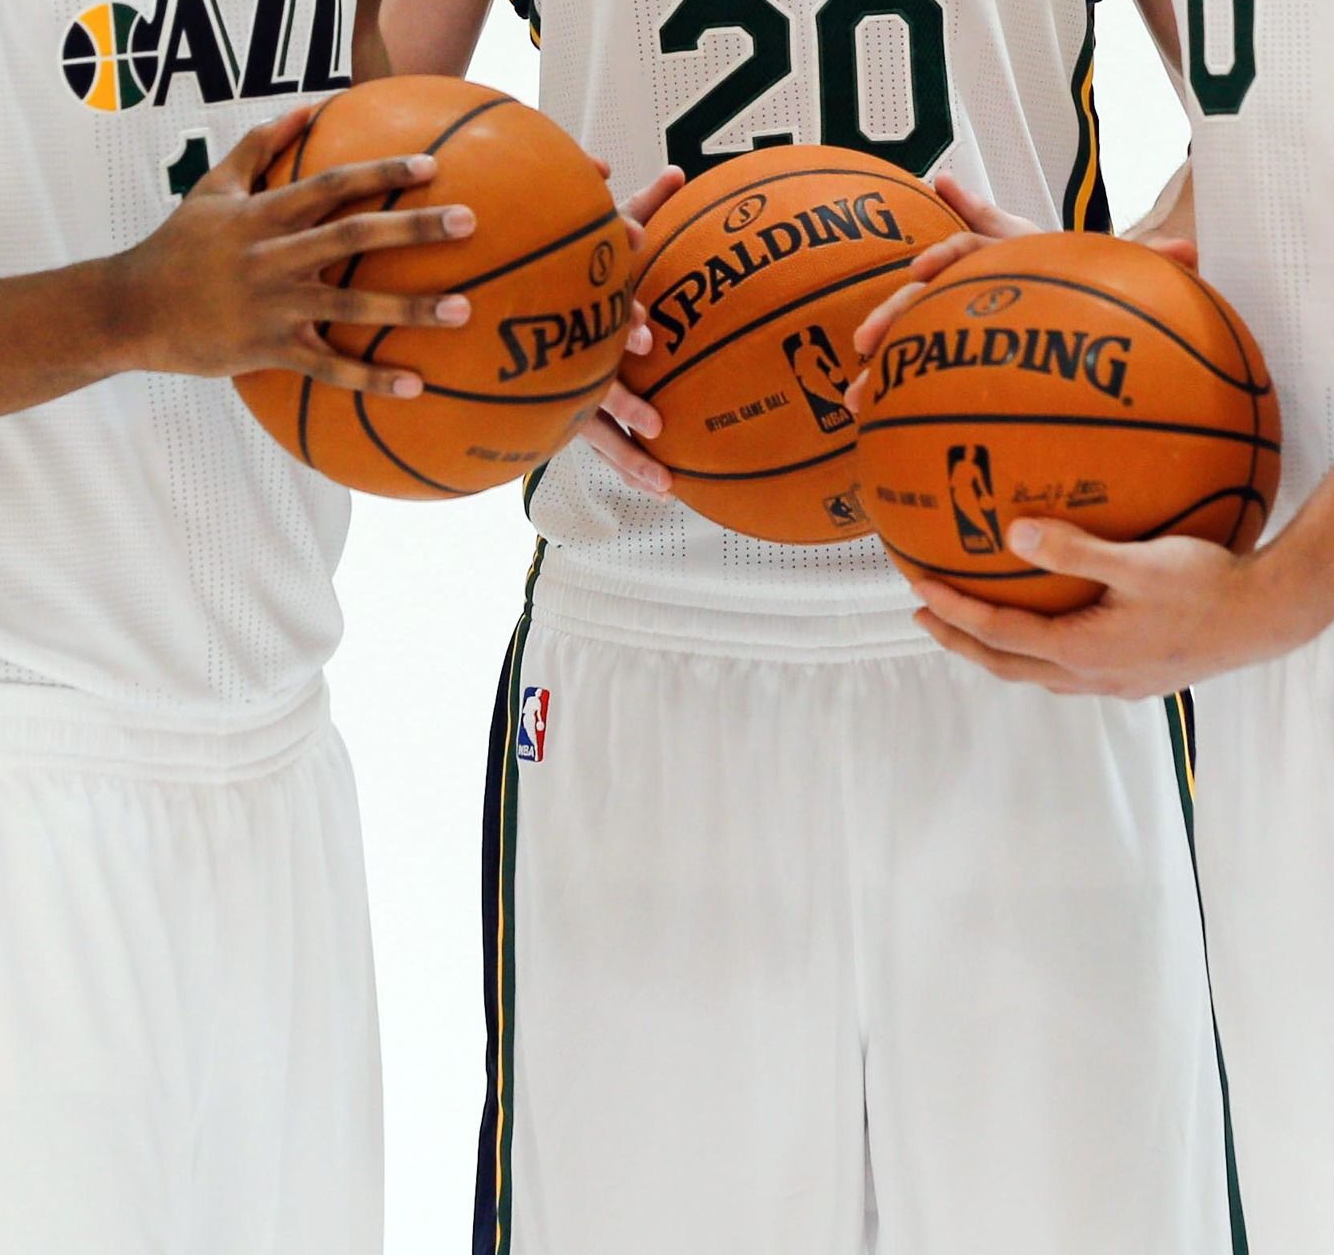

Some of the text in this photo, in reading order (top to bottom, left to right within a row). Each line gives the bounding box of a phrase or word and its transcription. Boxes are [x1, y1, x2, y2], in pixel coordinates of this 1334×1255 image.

[650, 192, 903, 354] SPALDING
[498, 280, 632, 382] SPALD
[874, 327, 1132, 405] SPALDING
[821, 407, 850, 430] NBA
[518, 744, 534, 757] NBA
